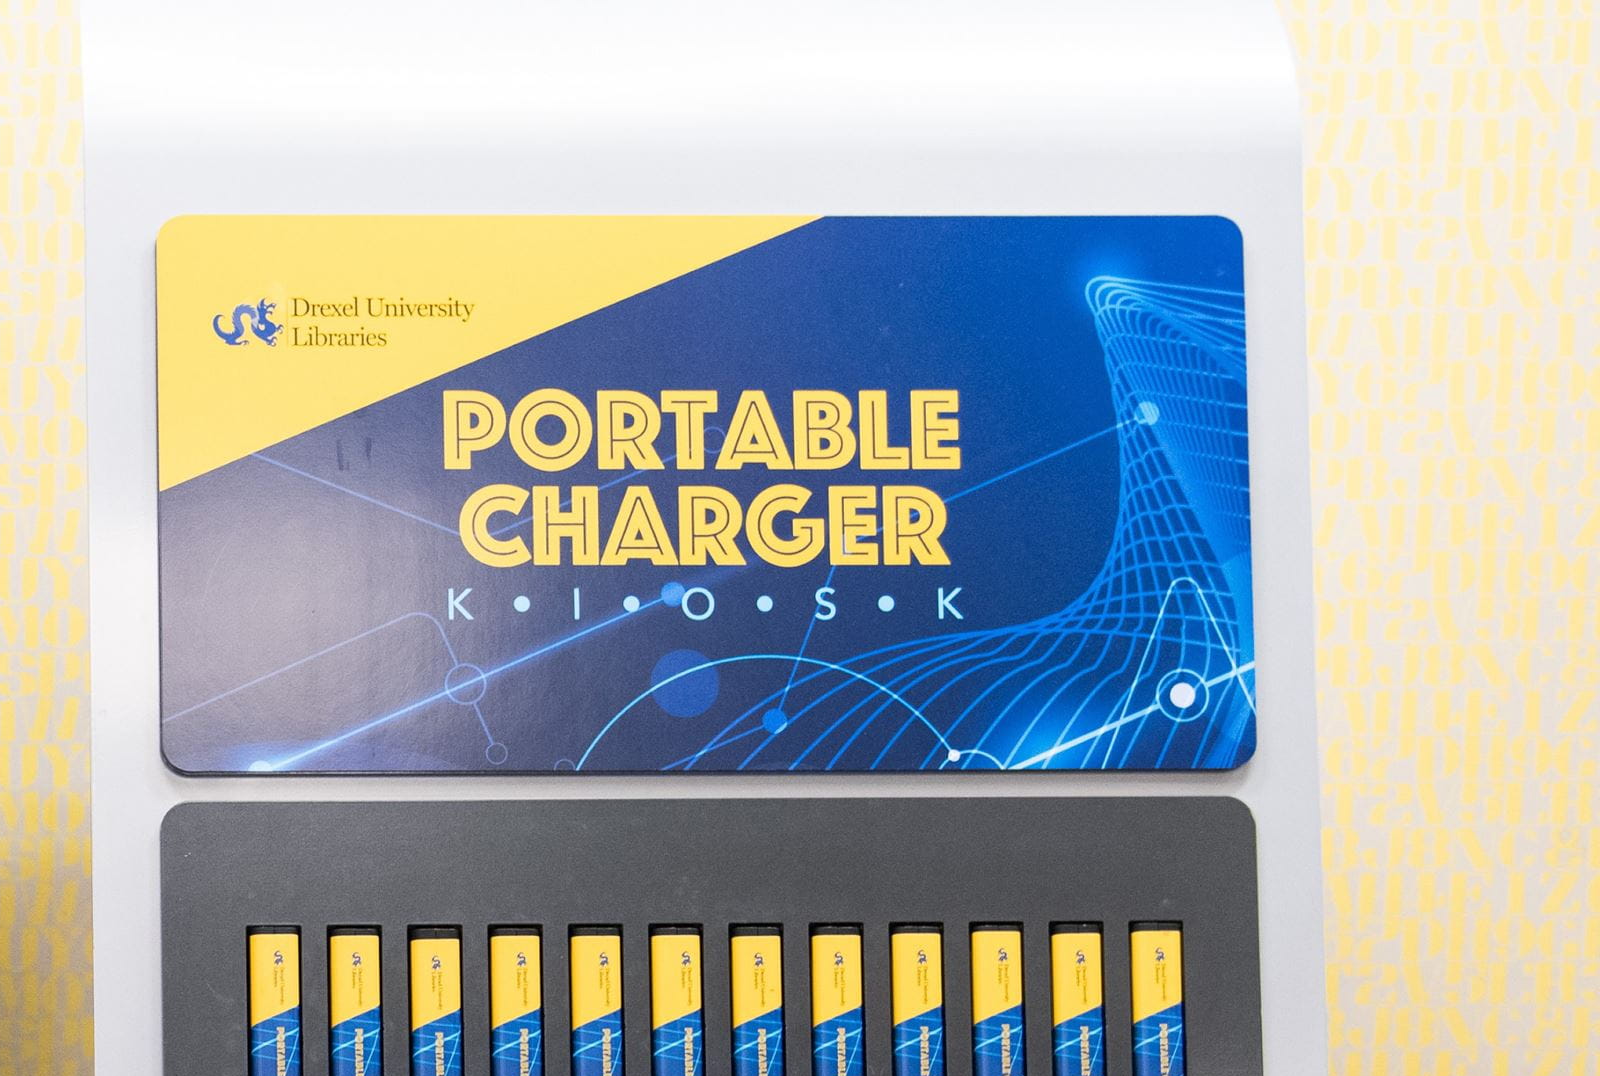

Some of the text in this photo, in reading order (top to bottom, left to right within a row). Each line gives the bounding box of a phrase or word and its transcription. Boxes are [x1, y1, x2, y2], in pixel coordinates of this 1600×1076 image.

[294, 297, 474, 322] Drexel University
[293, 326, 387, 346] Libraries
[442, 388, 961, 472] PORTABLE
[458, 483, 951, 568] CHARGER
[921, 1026, 929, 1076] PORTABLE
[1002, 1024, 1010, 1073] PORTABLE
[1081, 1027, 1089, 1076] PORTABLE
[1160, 1023, 1169, 1073] PORTABLE
